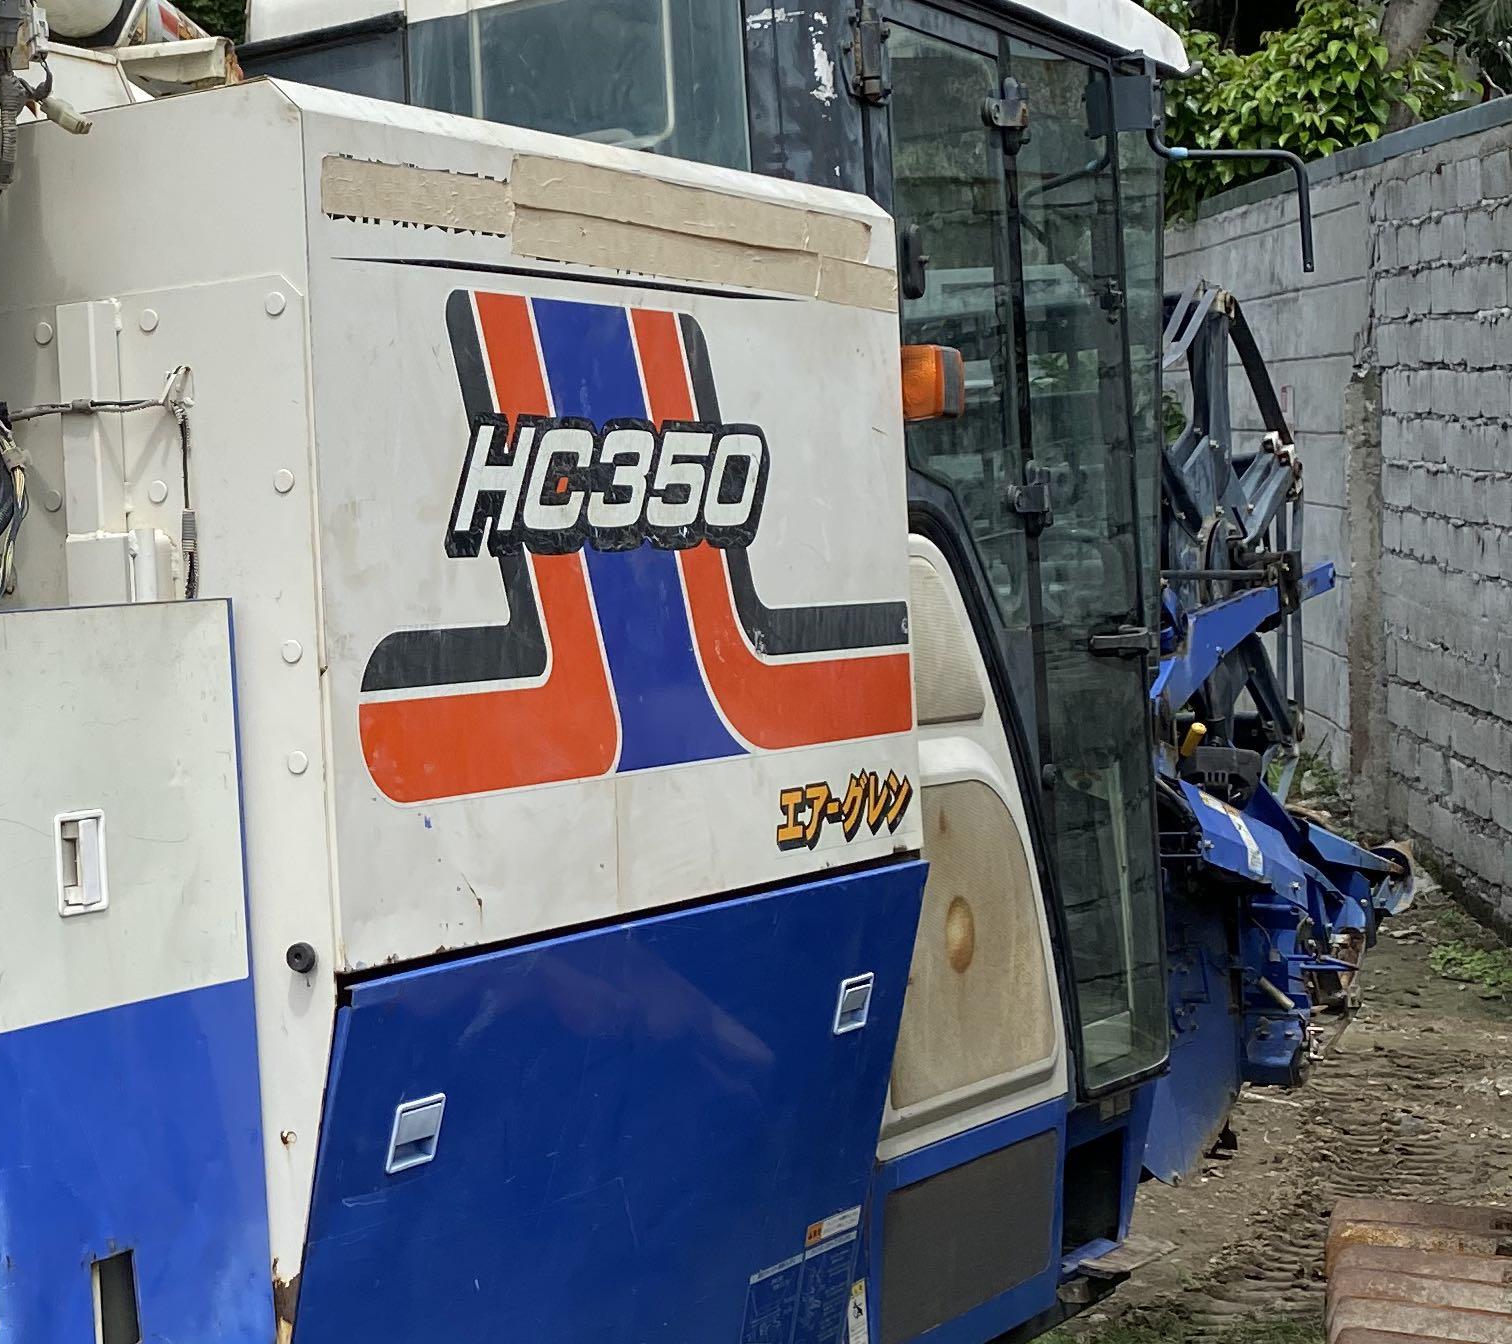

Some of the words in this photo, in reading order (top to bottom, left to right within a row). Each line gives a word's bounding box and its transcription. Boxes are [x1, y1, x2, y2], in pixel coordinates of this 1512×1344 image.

[445, 414, 770, 557] HC350
[777, 768, 913, 851] エアーグレン
